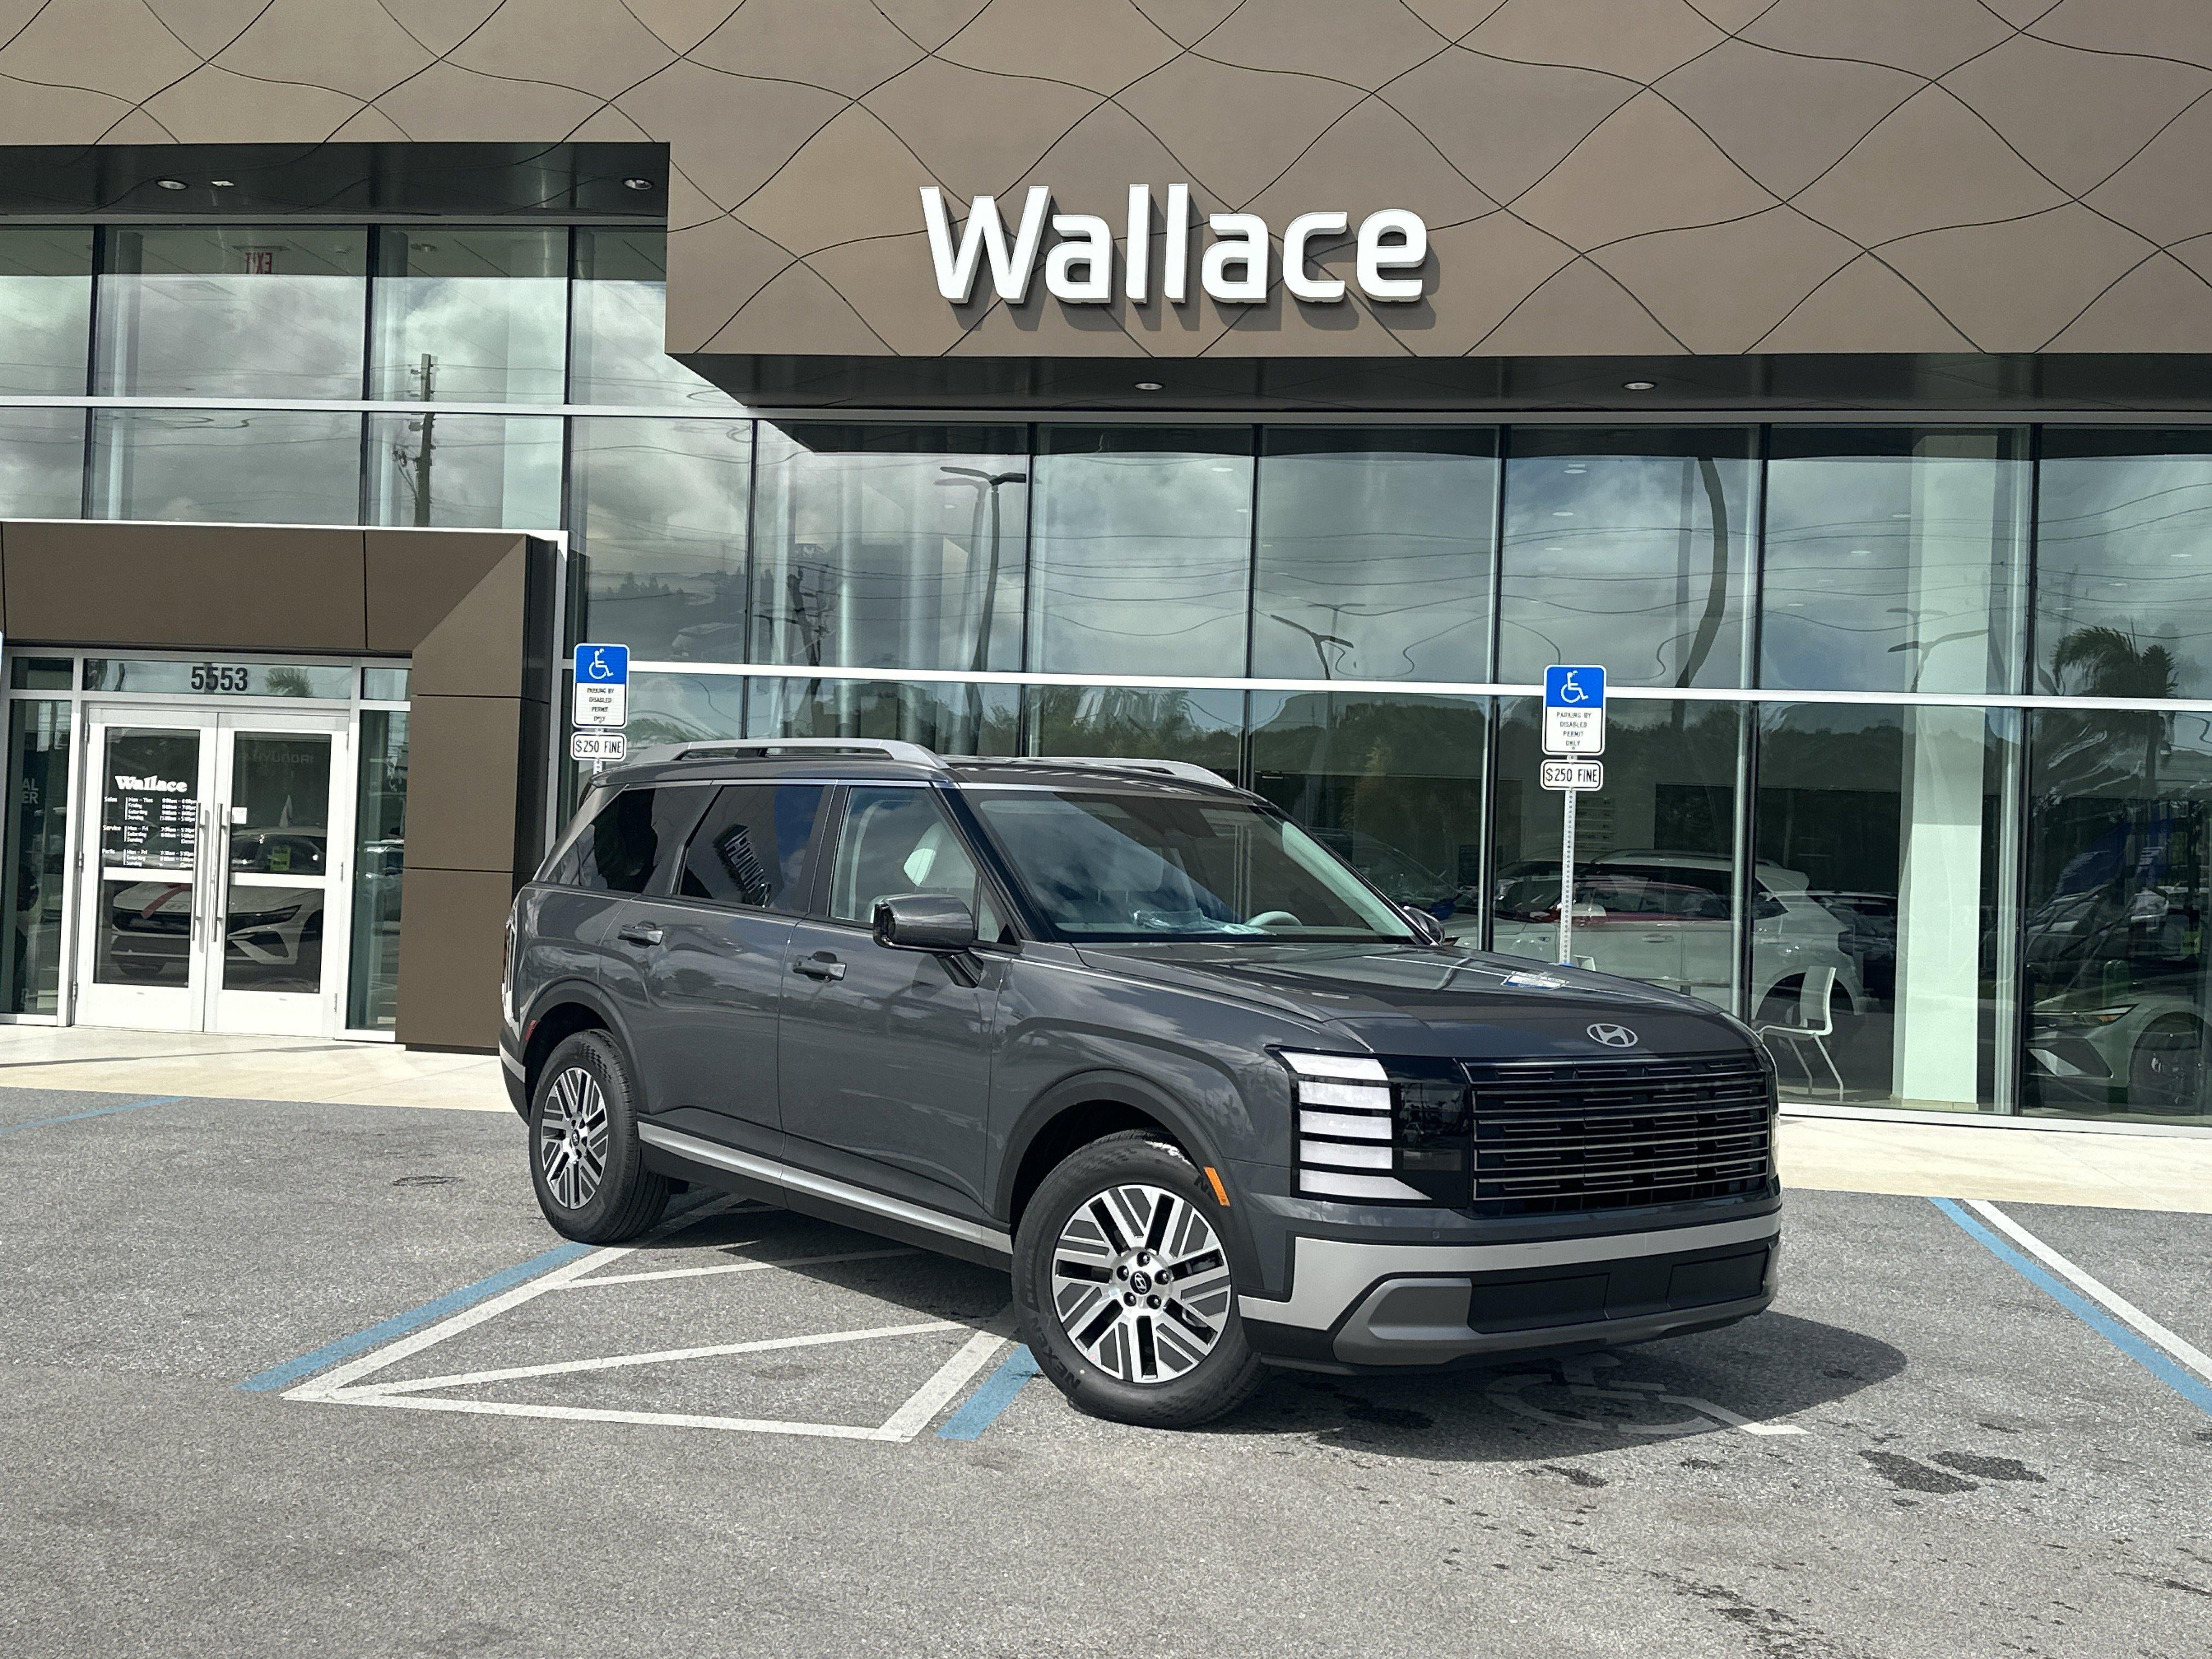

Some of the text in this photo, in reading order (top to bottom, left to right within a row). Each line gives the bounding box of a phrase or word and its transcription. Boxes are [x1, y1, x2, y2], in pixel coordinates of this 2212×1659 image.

[919, 183, 1427, 304] Wallace
[191, 667, 247, 691] 5553
[575, 739, 622, 753] $250 FINE
[115, 775, 188, 792] Wallace
[1545, 768, 1598, 782] $250 FINE
[1028, 1316, 1081, 1390] NEXEN
